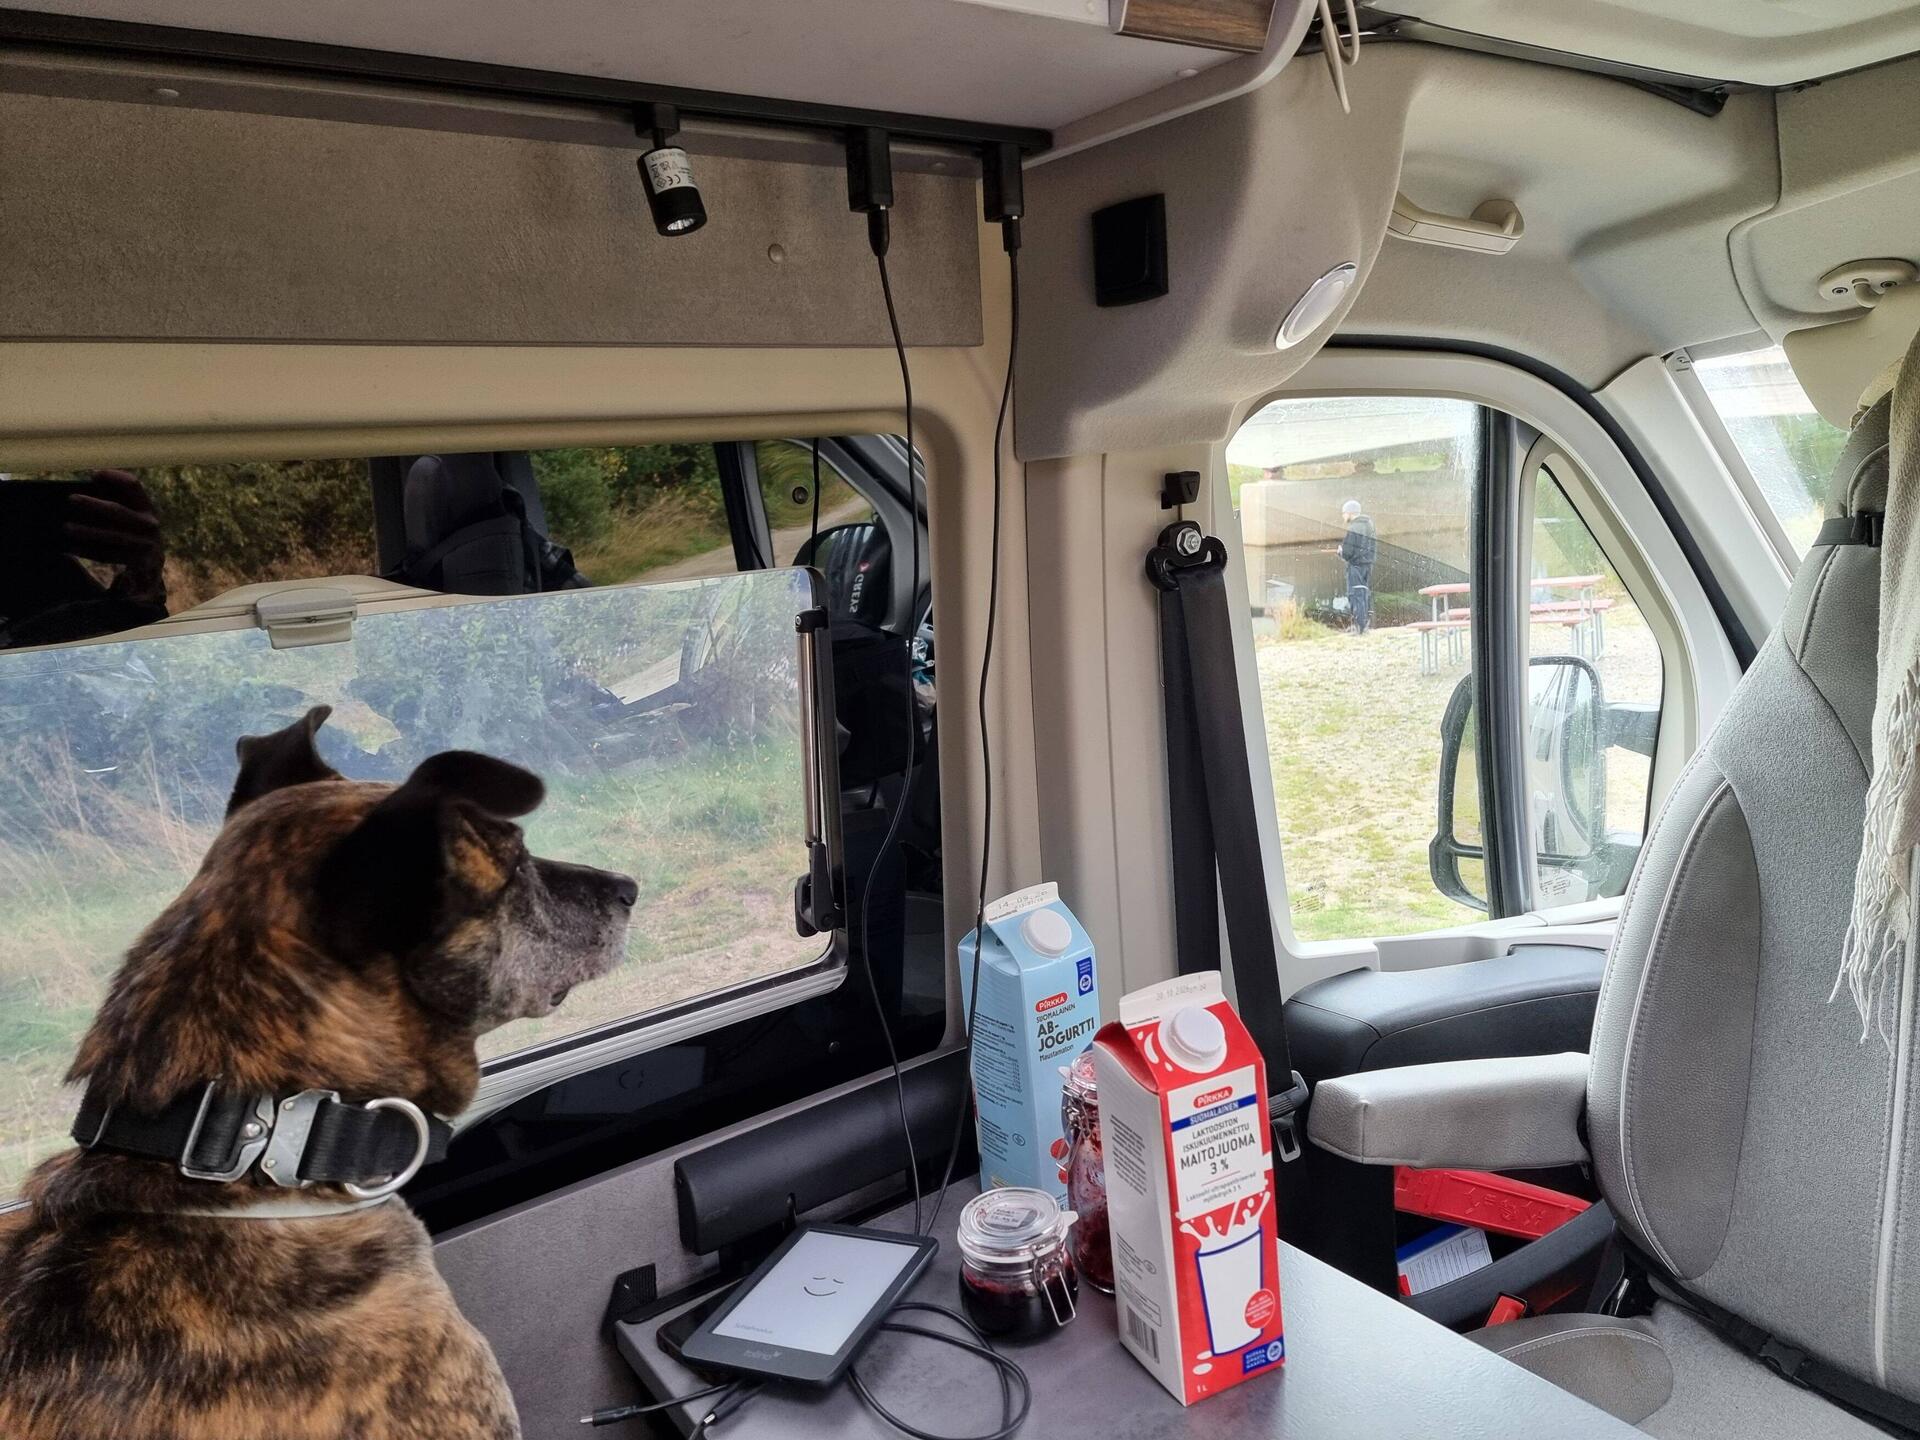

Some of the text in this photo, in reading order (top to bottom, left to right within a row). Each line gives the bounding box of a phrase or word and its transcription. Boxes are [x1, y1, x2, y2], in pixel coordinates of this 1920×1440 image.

[1036, 1003, 1076, 1023] SUOMALAINEN
[1037, 1021, 1059, 1038] AB-
[1038, 1017, 1095, 1052] JOGURTTI
[1039, 1044, 1074, 1062] Maustamaton
[1190, 1101, 1239, 1125] SUOMALAINEN
[1182, 1123, 1250, 1153] ISKUKUUMENNETTU
[1192, 1117, 1238, 1139] LAKTOOSITON
[1180, 1133, 1256, 1170] MAITOJUOMA
[1210, 1158, 1229, 1175] 3 %
